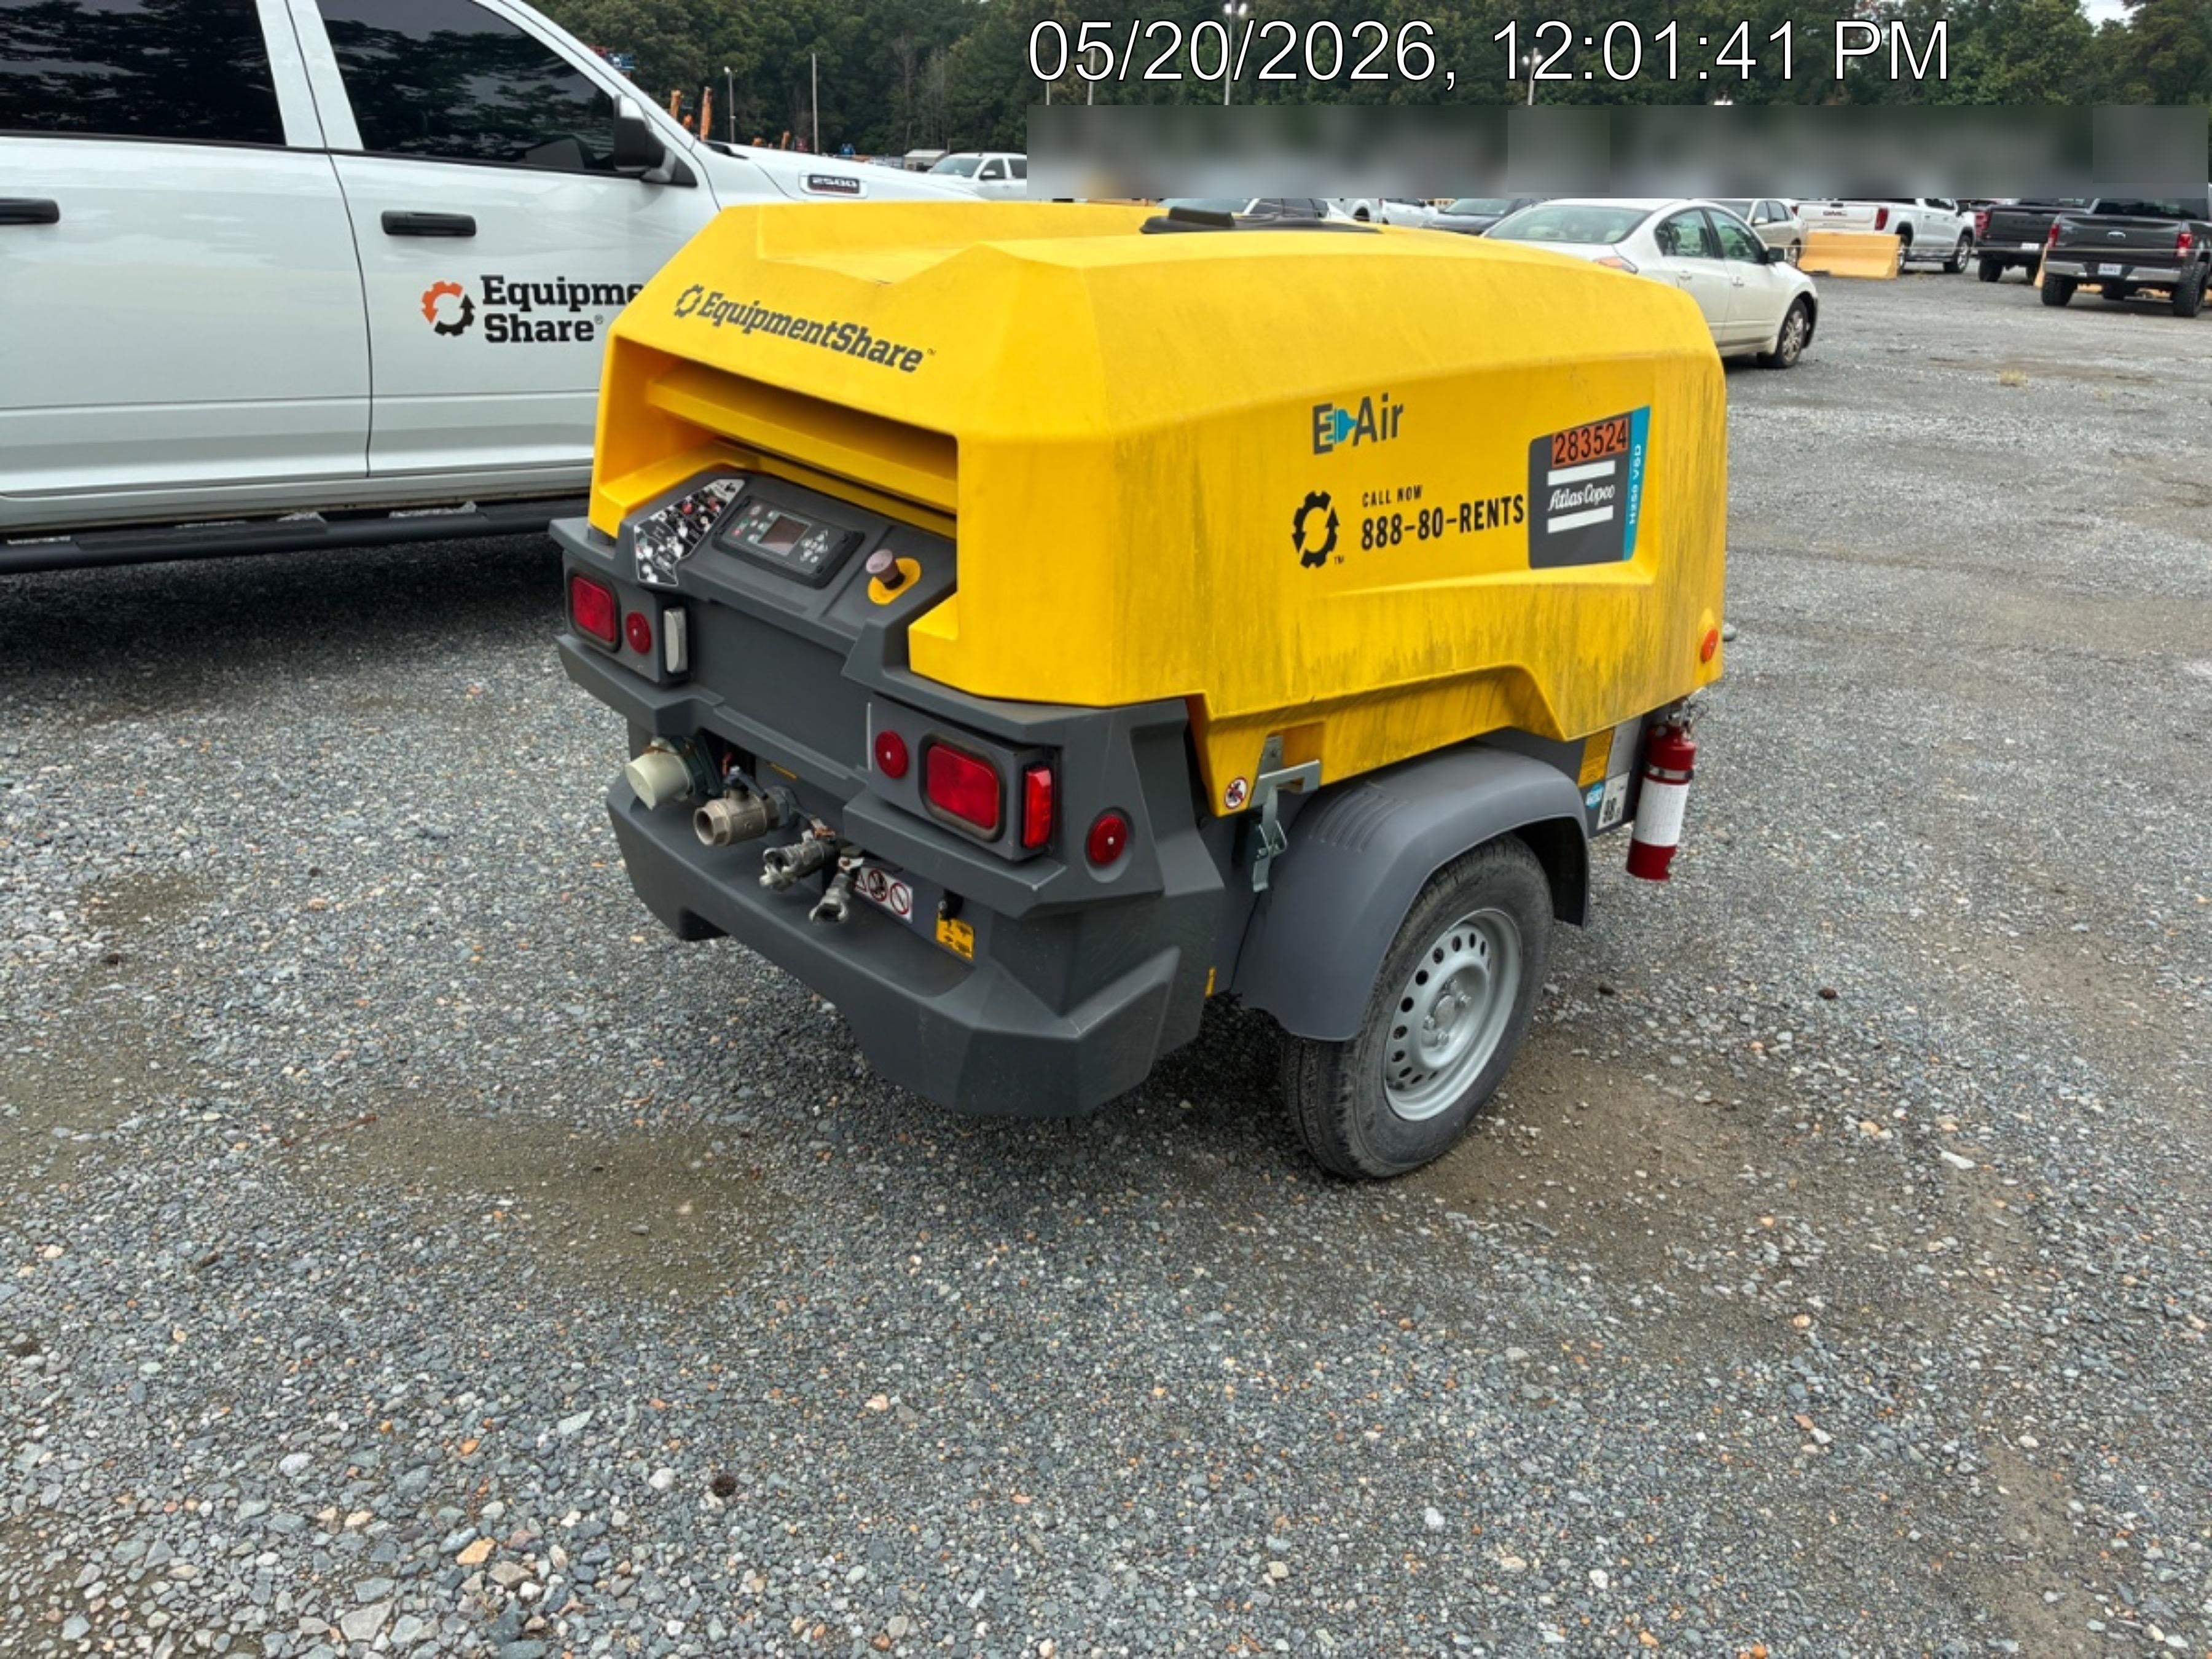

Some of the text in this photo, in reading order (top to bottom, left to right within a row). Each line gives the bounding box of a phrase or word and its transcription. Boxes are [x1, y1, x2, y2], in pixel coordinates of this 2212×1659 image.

[812, 176, 857, 187] 2500
[1554, 420, 1627, 465] 283524
[1362, 484, 1423, 508] CALL NOW
[1361, 493, 1524, 551] 888-80-RENTS
